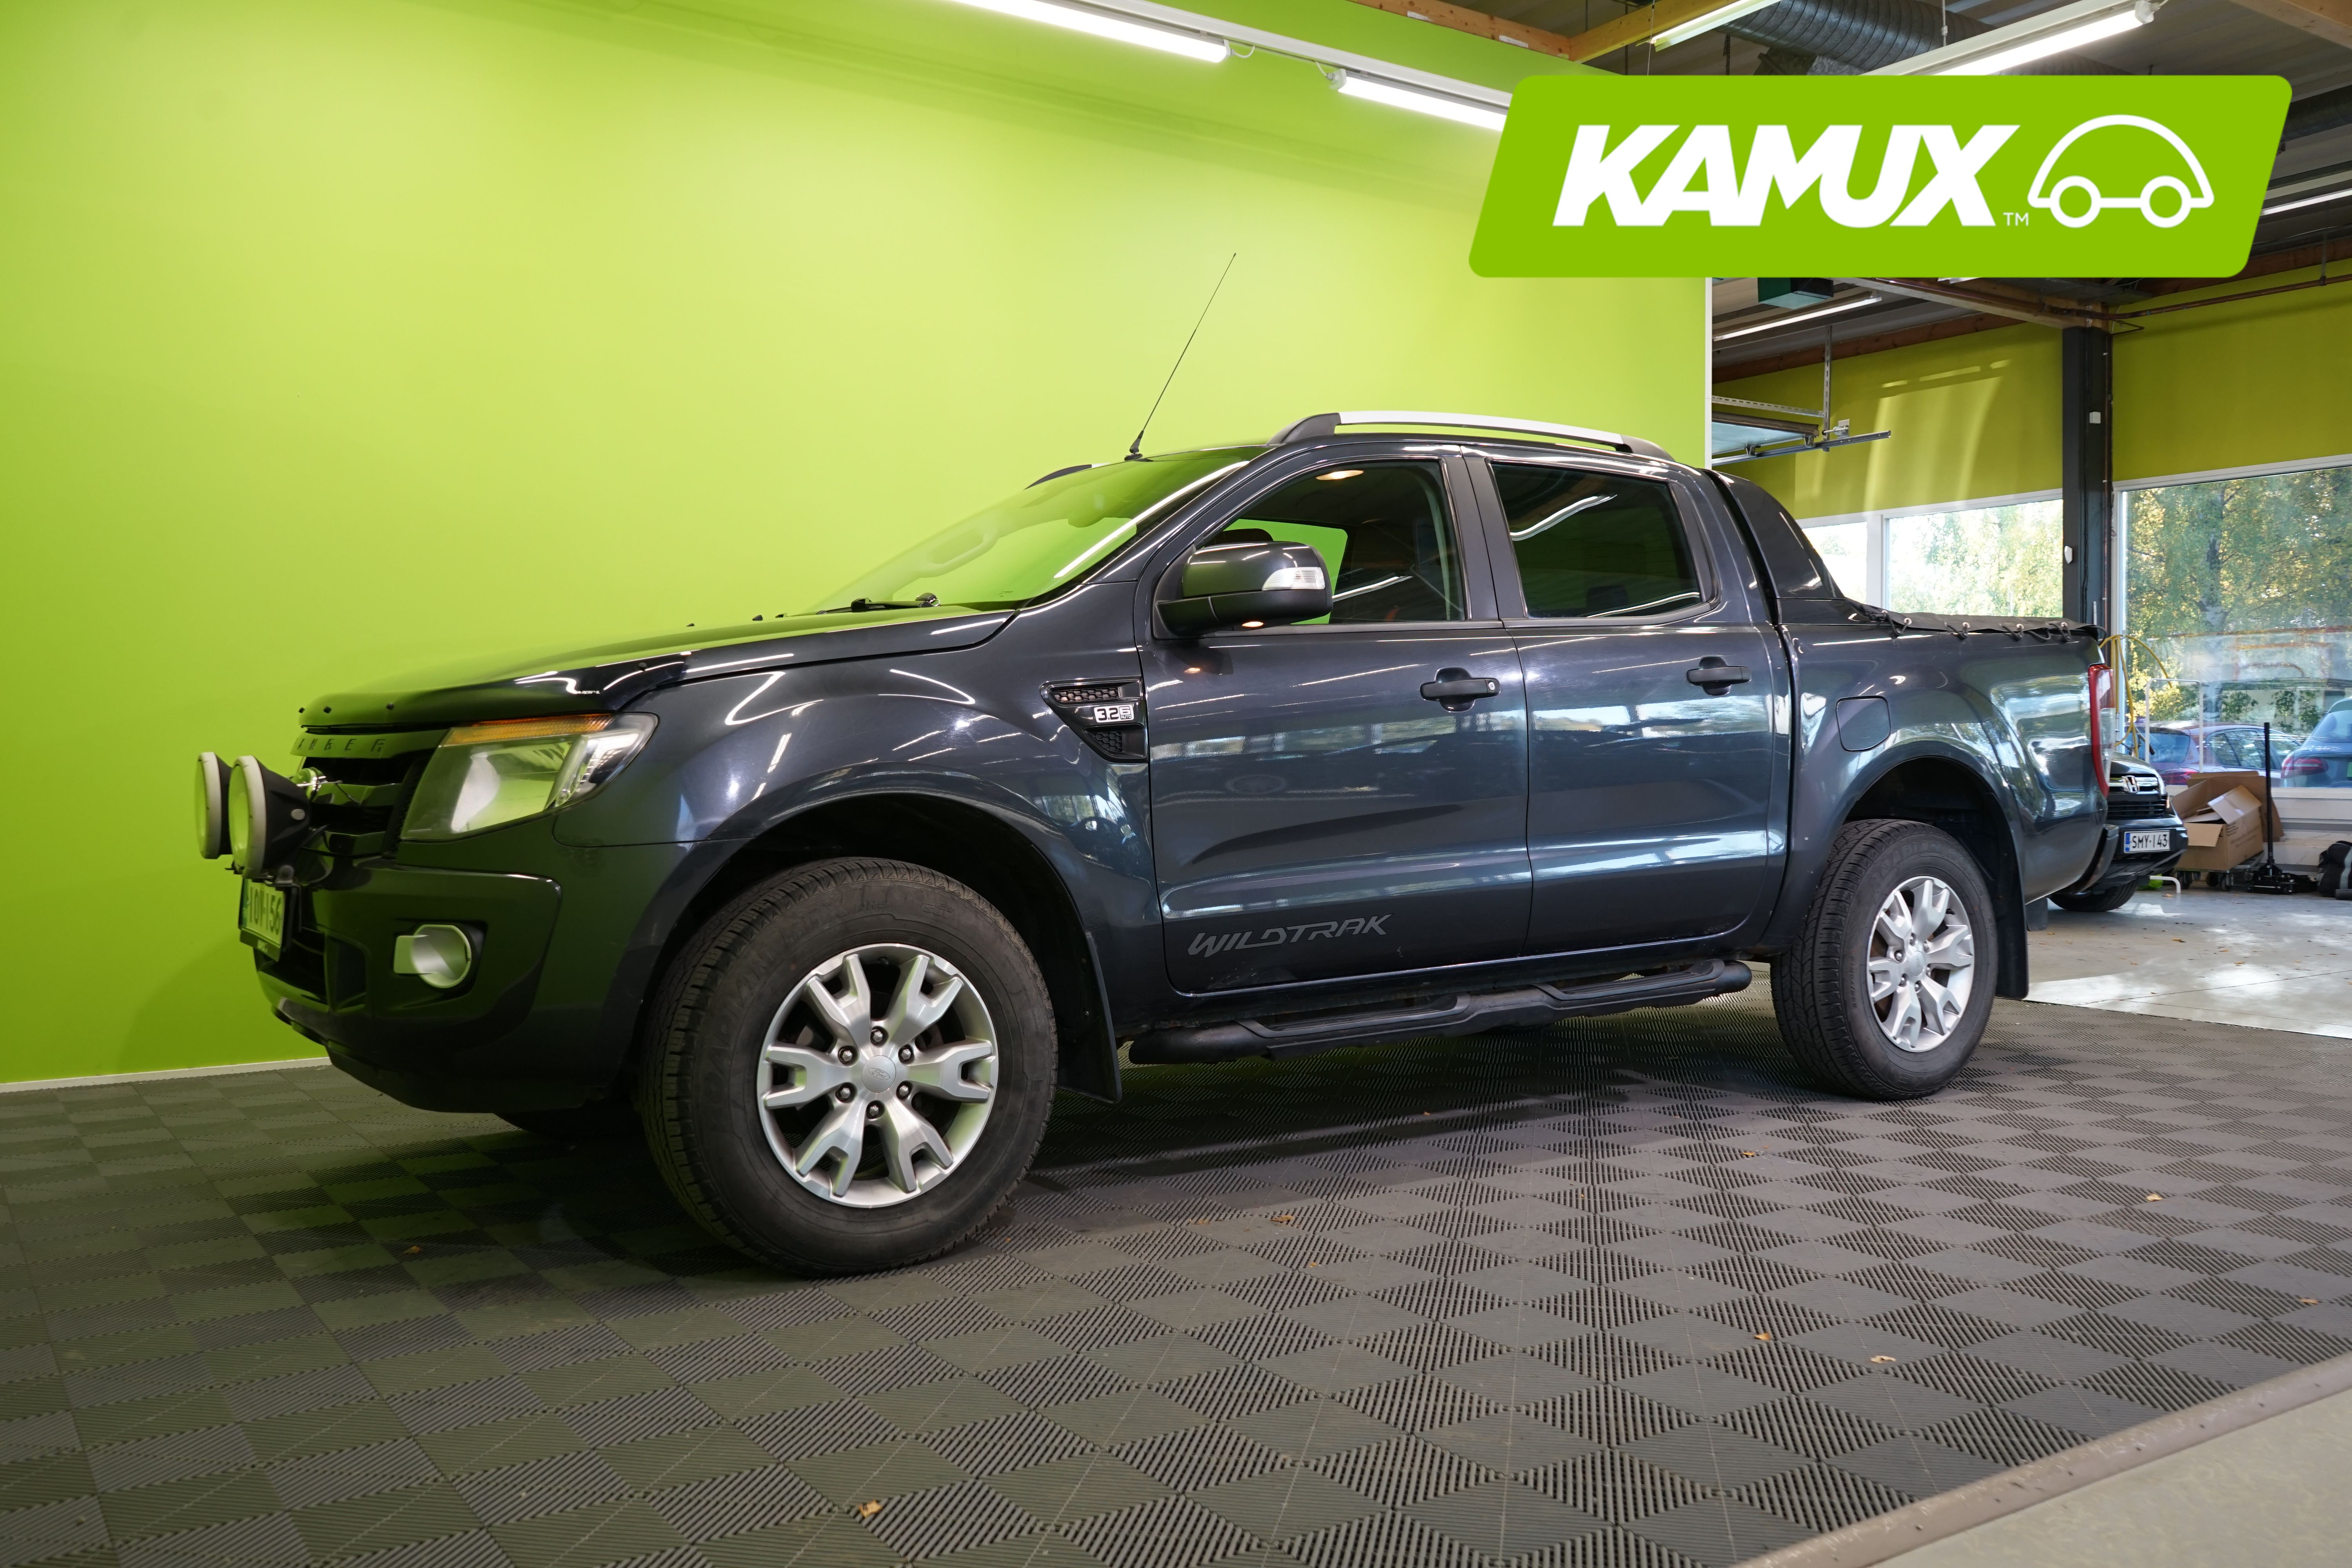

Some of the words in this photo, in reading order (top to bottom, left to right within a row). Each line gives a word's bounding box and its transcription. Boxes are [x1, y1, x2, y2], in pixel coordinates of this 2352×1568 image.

[1097, 708, 1119, 721] 3.2
[2132, 834, 2168, 848] SMY-143
[1187, 914, 1394, 957] WILDTRAK
